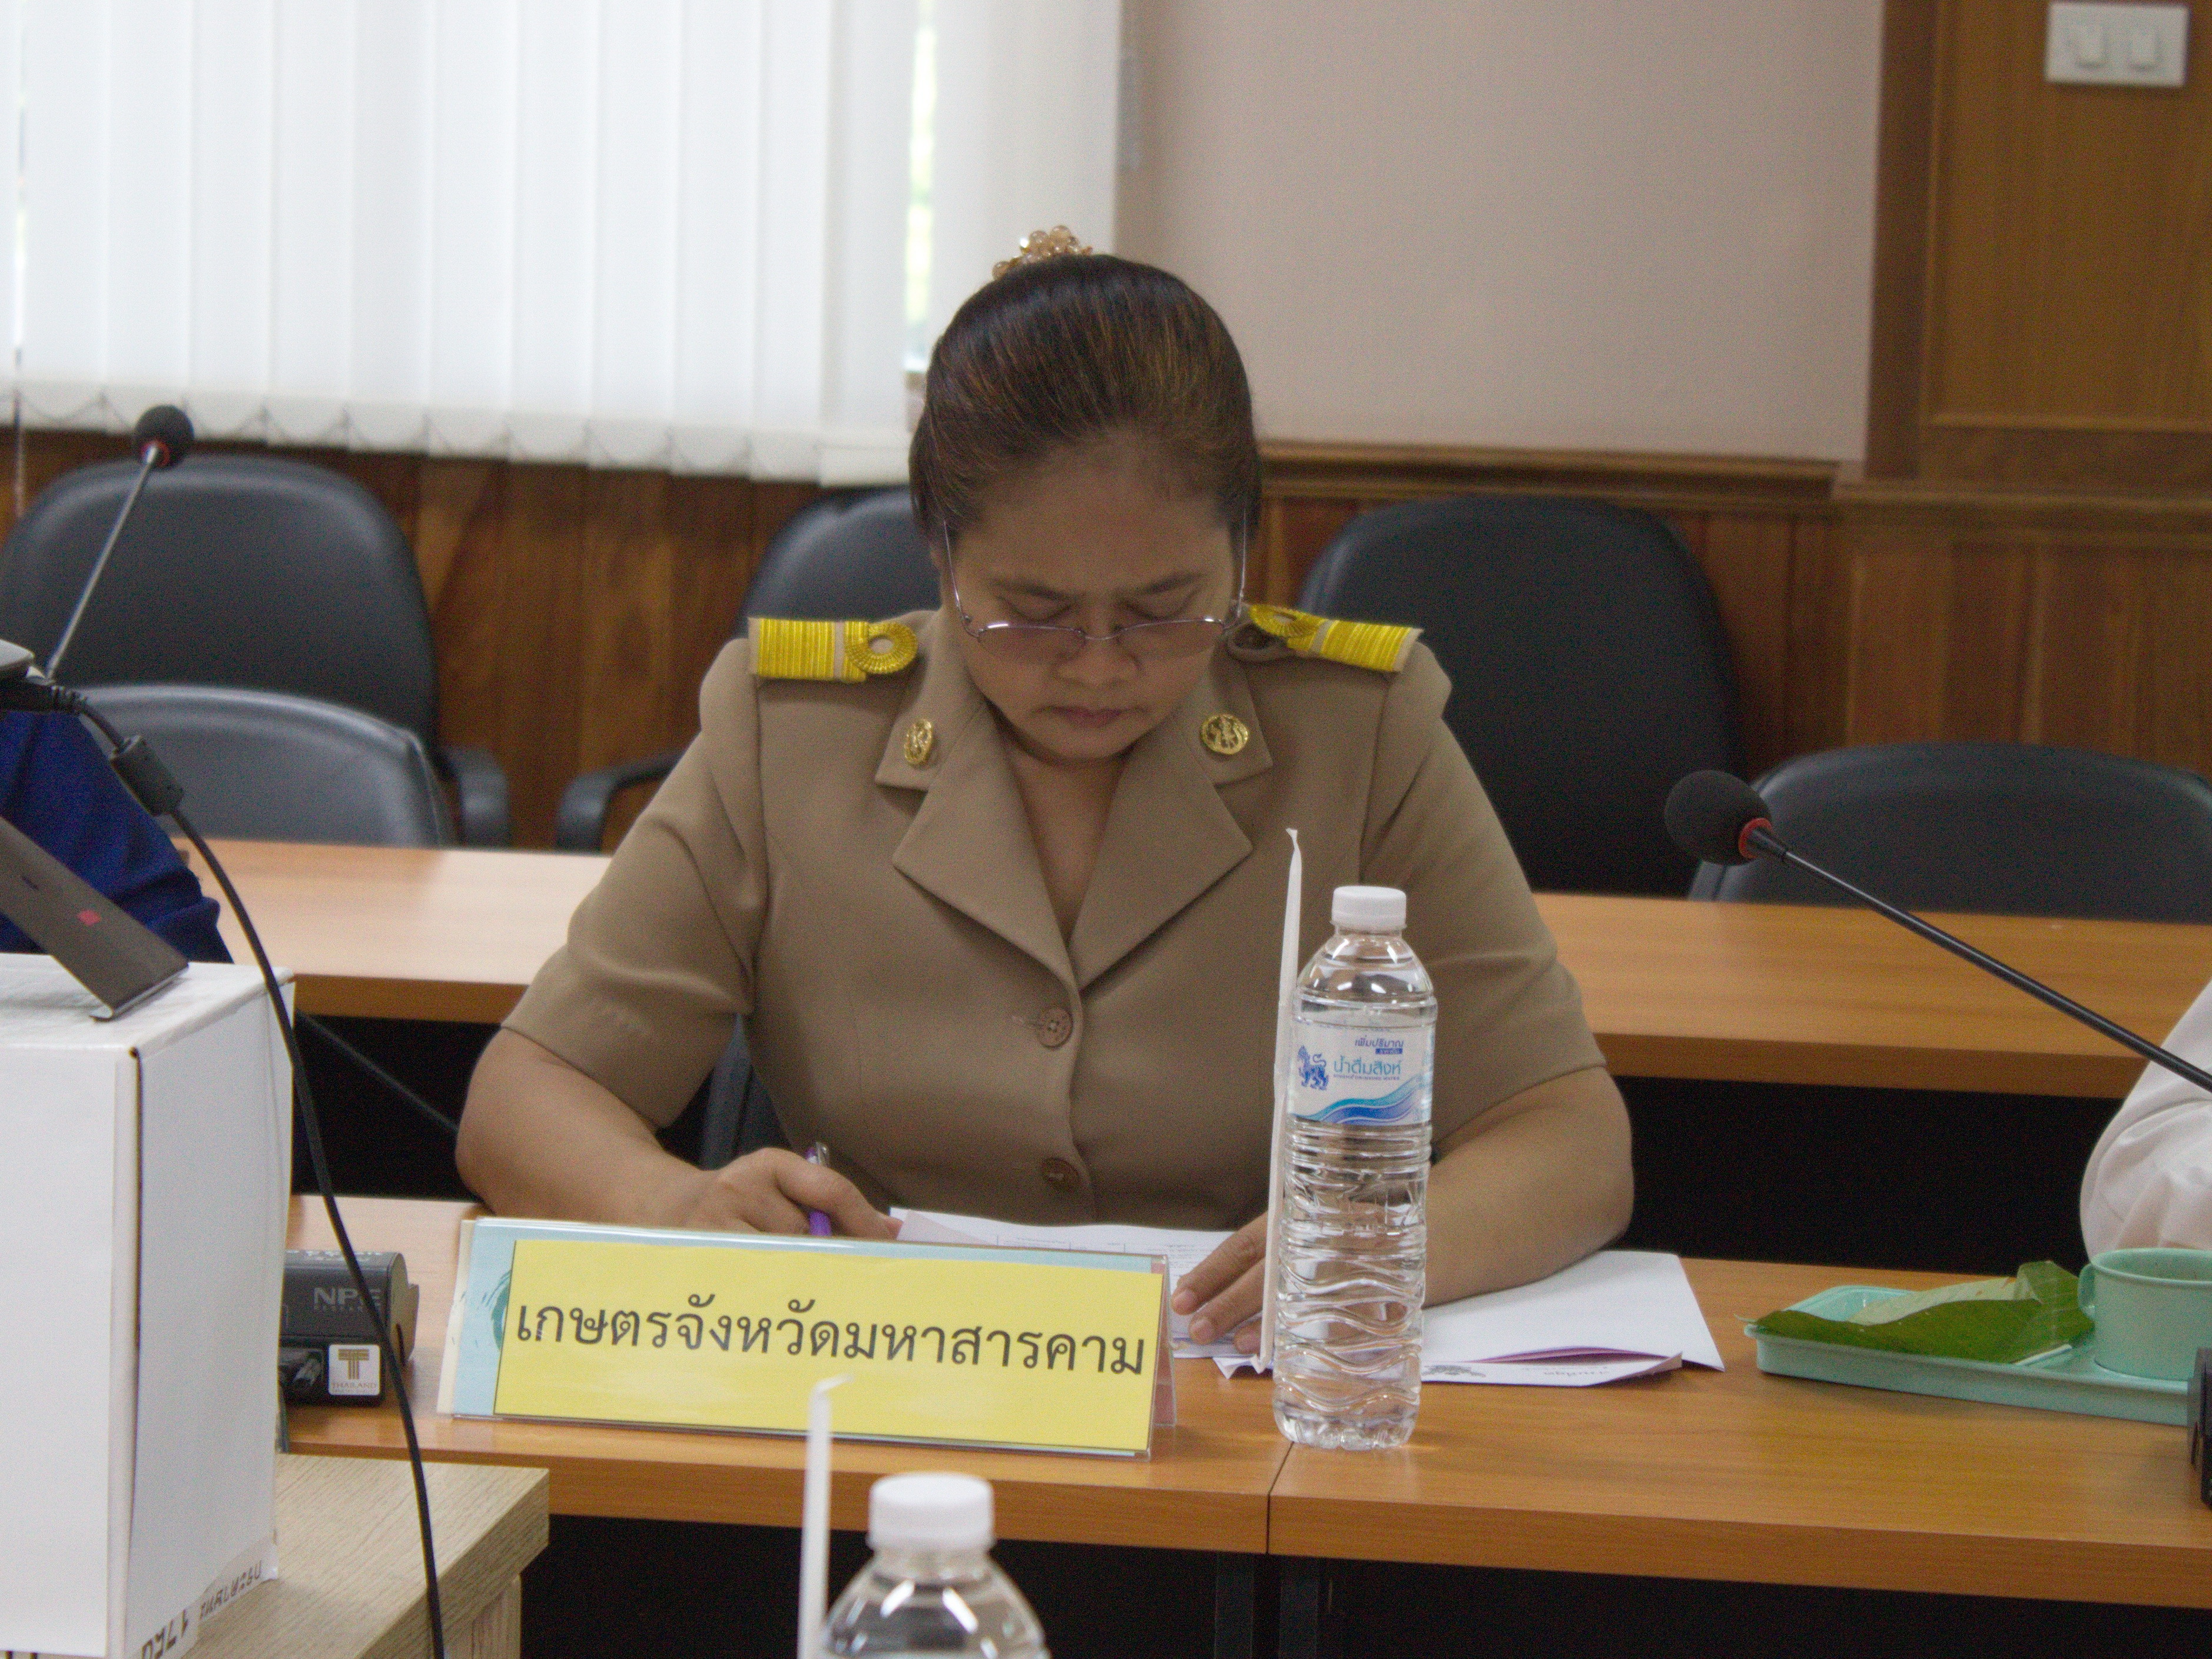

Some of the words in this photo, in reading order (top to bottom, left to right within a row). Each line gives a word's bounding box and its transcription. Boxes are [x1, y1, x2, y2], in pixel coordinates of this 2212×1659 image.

[518, 1293, 1144, 1375] เกษตรจังหวัดมหาสารคาม
